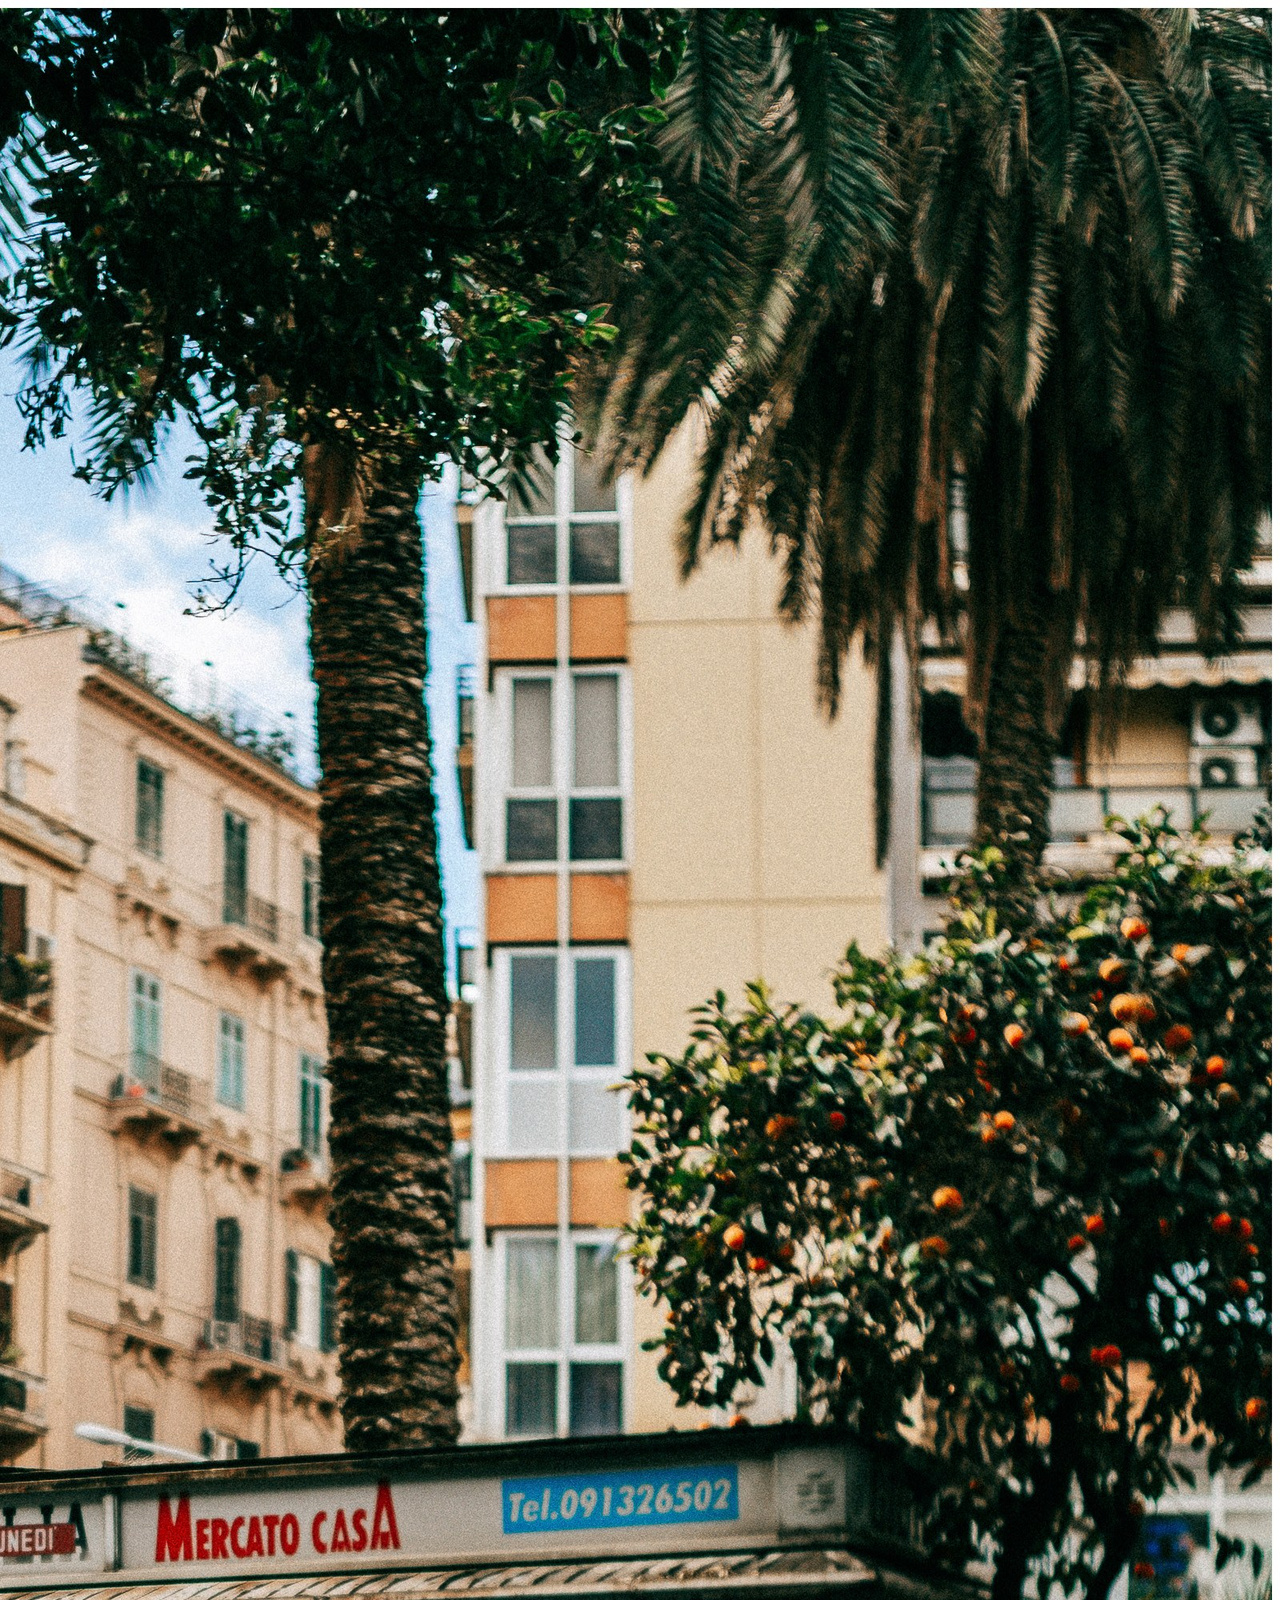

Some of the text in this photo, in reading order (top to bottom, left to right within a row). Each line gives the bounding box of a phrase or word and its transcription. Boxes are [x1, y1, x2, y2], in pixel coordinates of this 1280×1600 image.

[155, 1477, 401, 1562] MERCATO CASA
[509, 1478, 732, 1523] Tel.091326502
